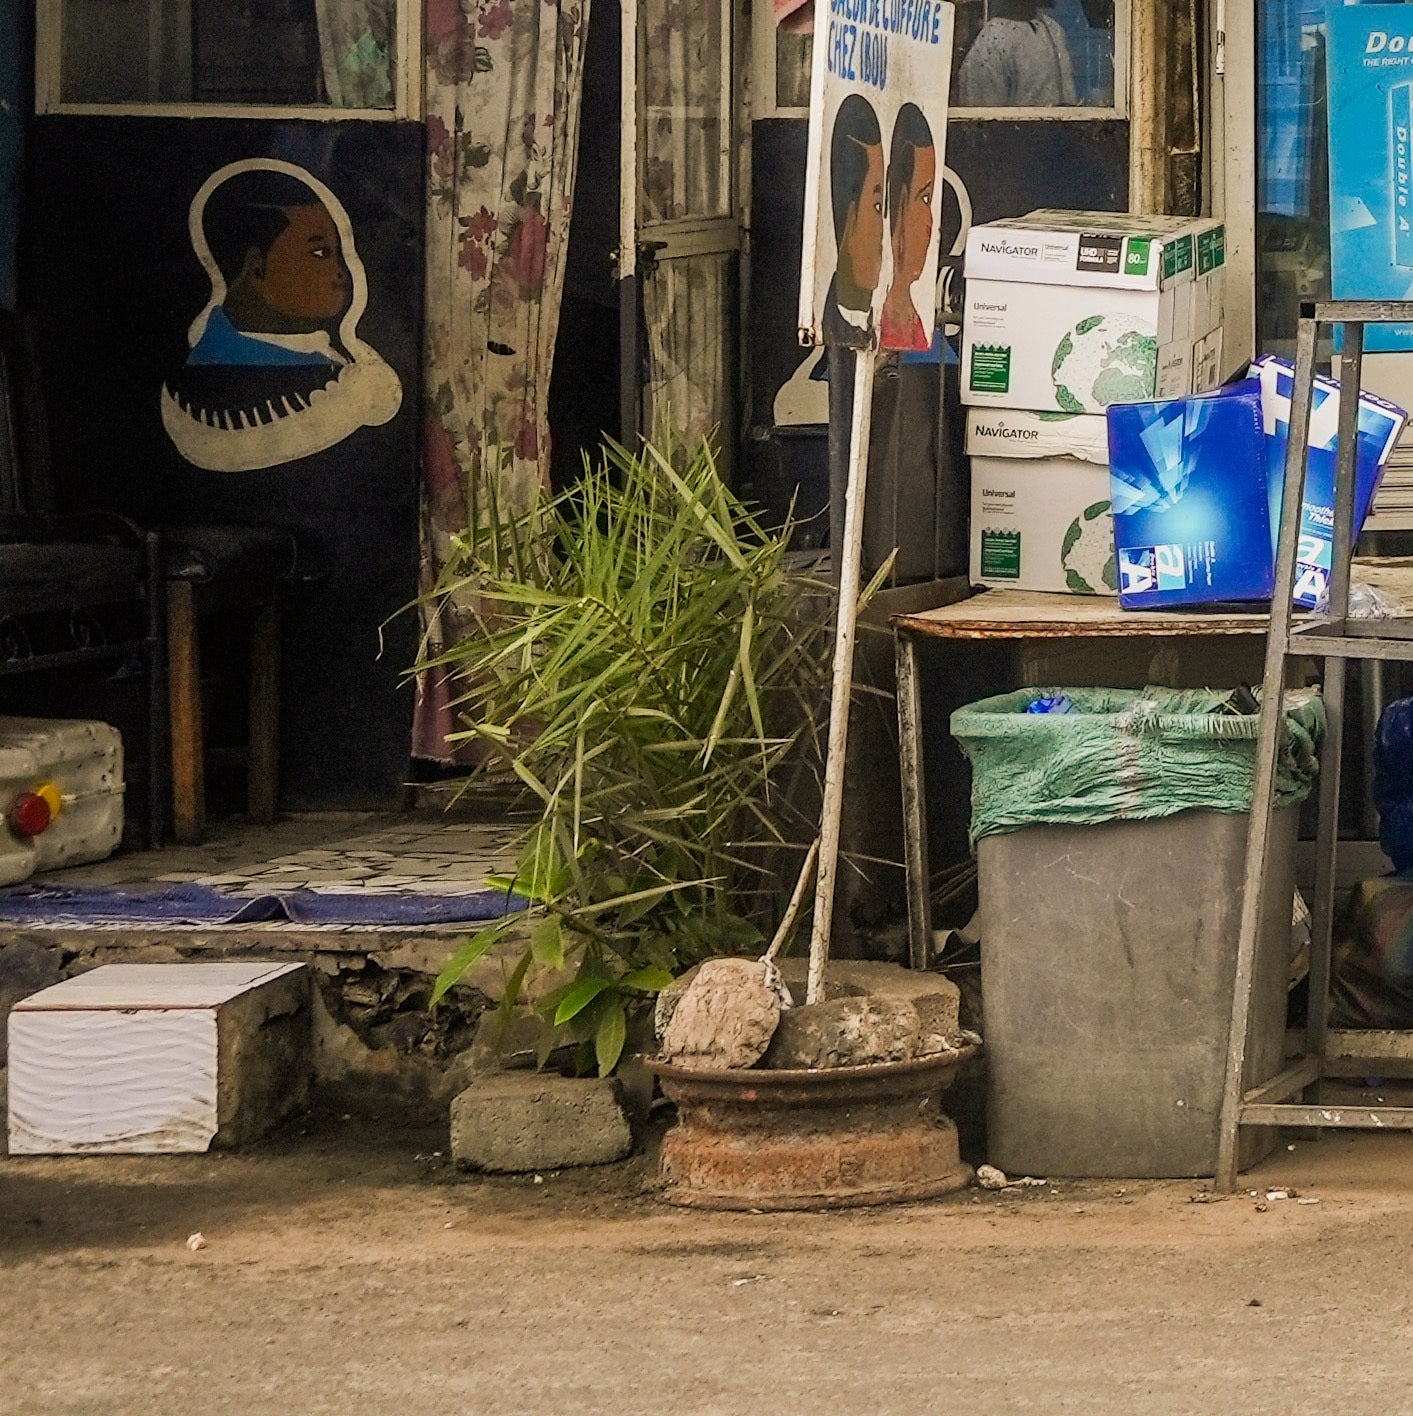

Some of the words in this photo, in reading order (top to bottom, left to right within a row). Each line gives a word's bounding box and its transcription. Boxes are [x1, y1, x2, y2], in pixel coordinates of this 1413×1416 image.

[827, 20, 857, 81] CHEZ
[860, 30, 889, 91] IBOU
[1363, 57, 1380, 66] THE
[1395, 126, 1409, 208] Double
[981, 241, 1039, 257] NAVIGATOR
[1127, 252, 1140, 265] 80
[975, 424, 1039, 440] NAVIGATOR
